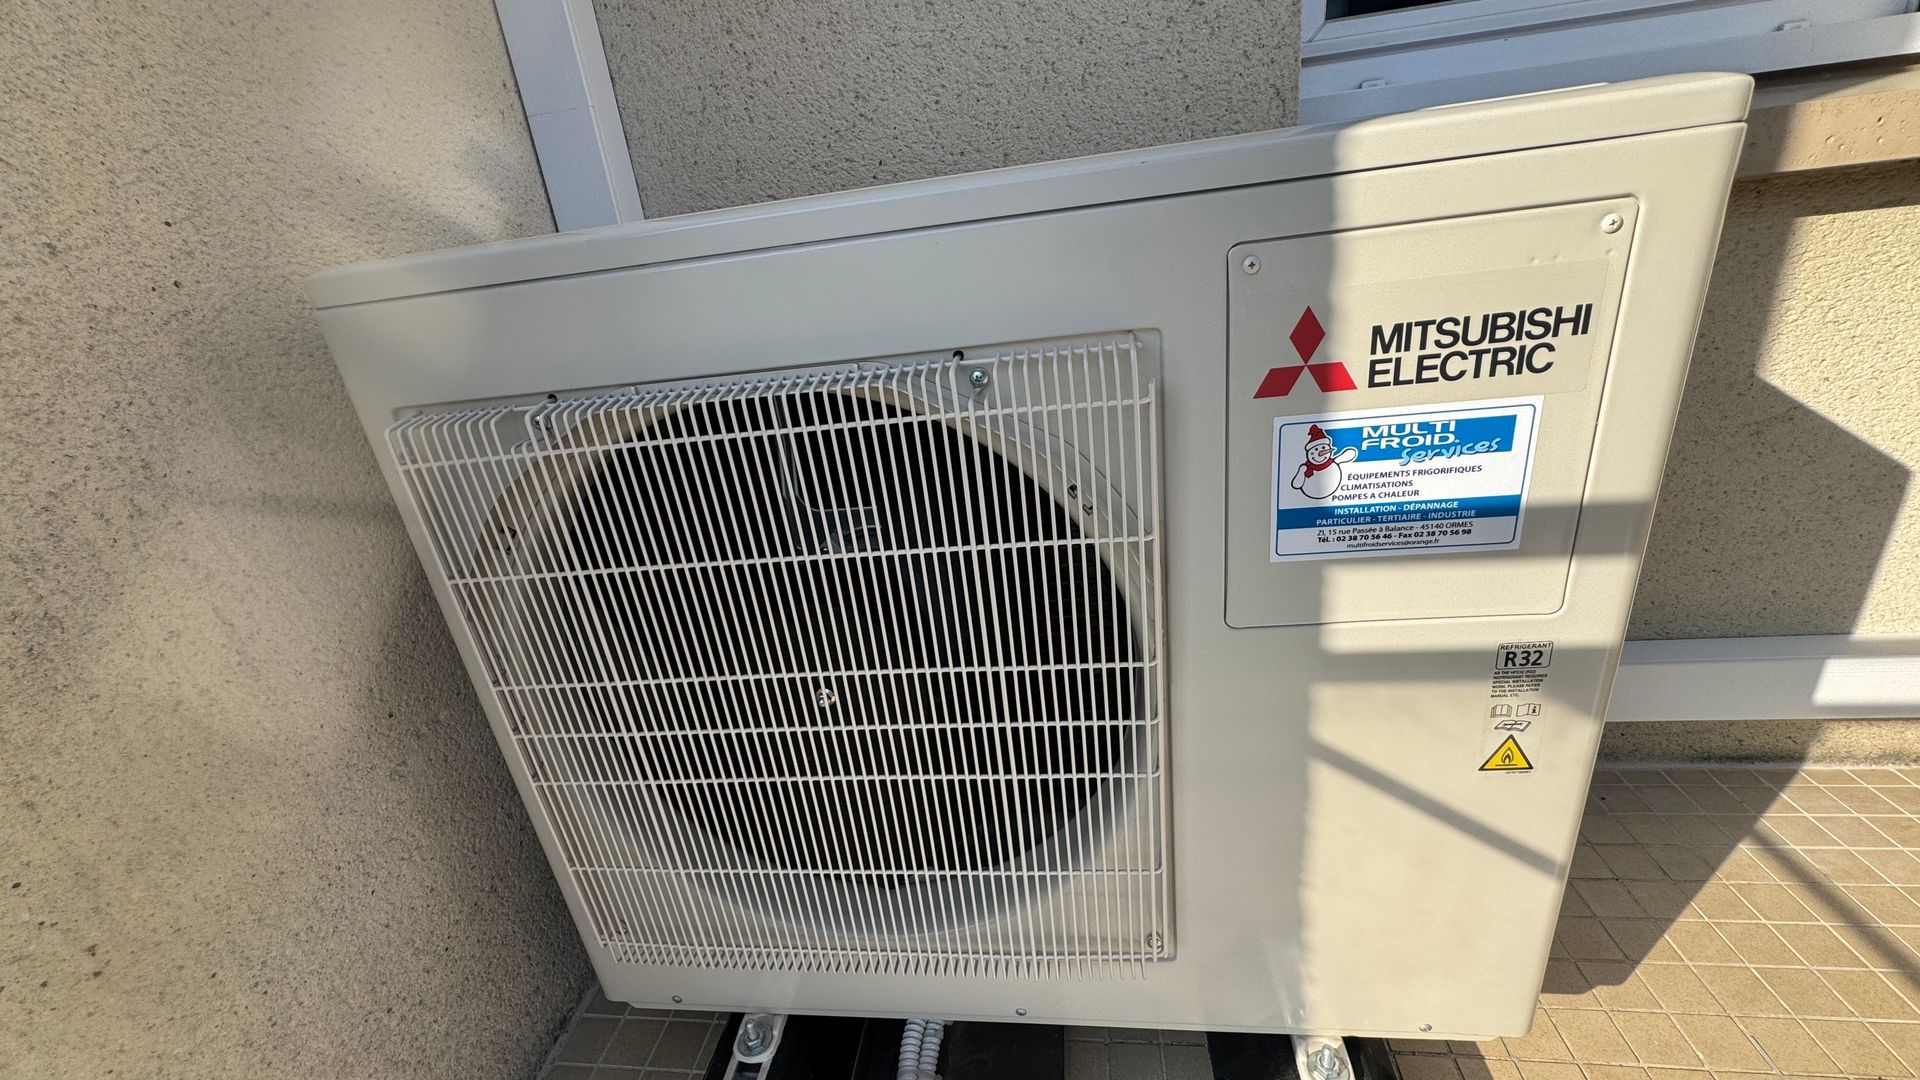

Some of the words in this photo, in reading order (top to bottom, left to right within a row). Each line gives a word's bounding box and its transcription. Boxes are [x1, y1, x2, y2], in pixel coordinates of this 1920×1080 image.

[1370, 303, 1593, 355] MITSUBISHI
[1367, 343, 1556, 388] ELECTRIC
[1362, 420, 1456, 439] MULTI
[1361, 433, 1456, 451] FROID
[1347, 469, 1410, 481] ÉQUIPEMENTS
[1412, 465, 1483, 476] FRIGORIFIQUES
[1340, 480, 1413, 491] CLIMATISATIONS
[1331, 492, 1368, 502] POMPES
[1378, 489, 1420, 499] CHALEUR
[1334, 504, 1397, 515] INSTALLATION
[1403, 501, 1459, 511] DÉPANNAGE
[1316, 516, 1371, 526] PARTICULIER
[1377, 513, 1421, 523] TERTIAIRE
[1428, 509, 1477, 519] INDUSTRIE
[1504, 649, 1544, 667] R32
